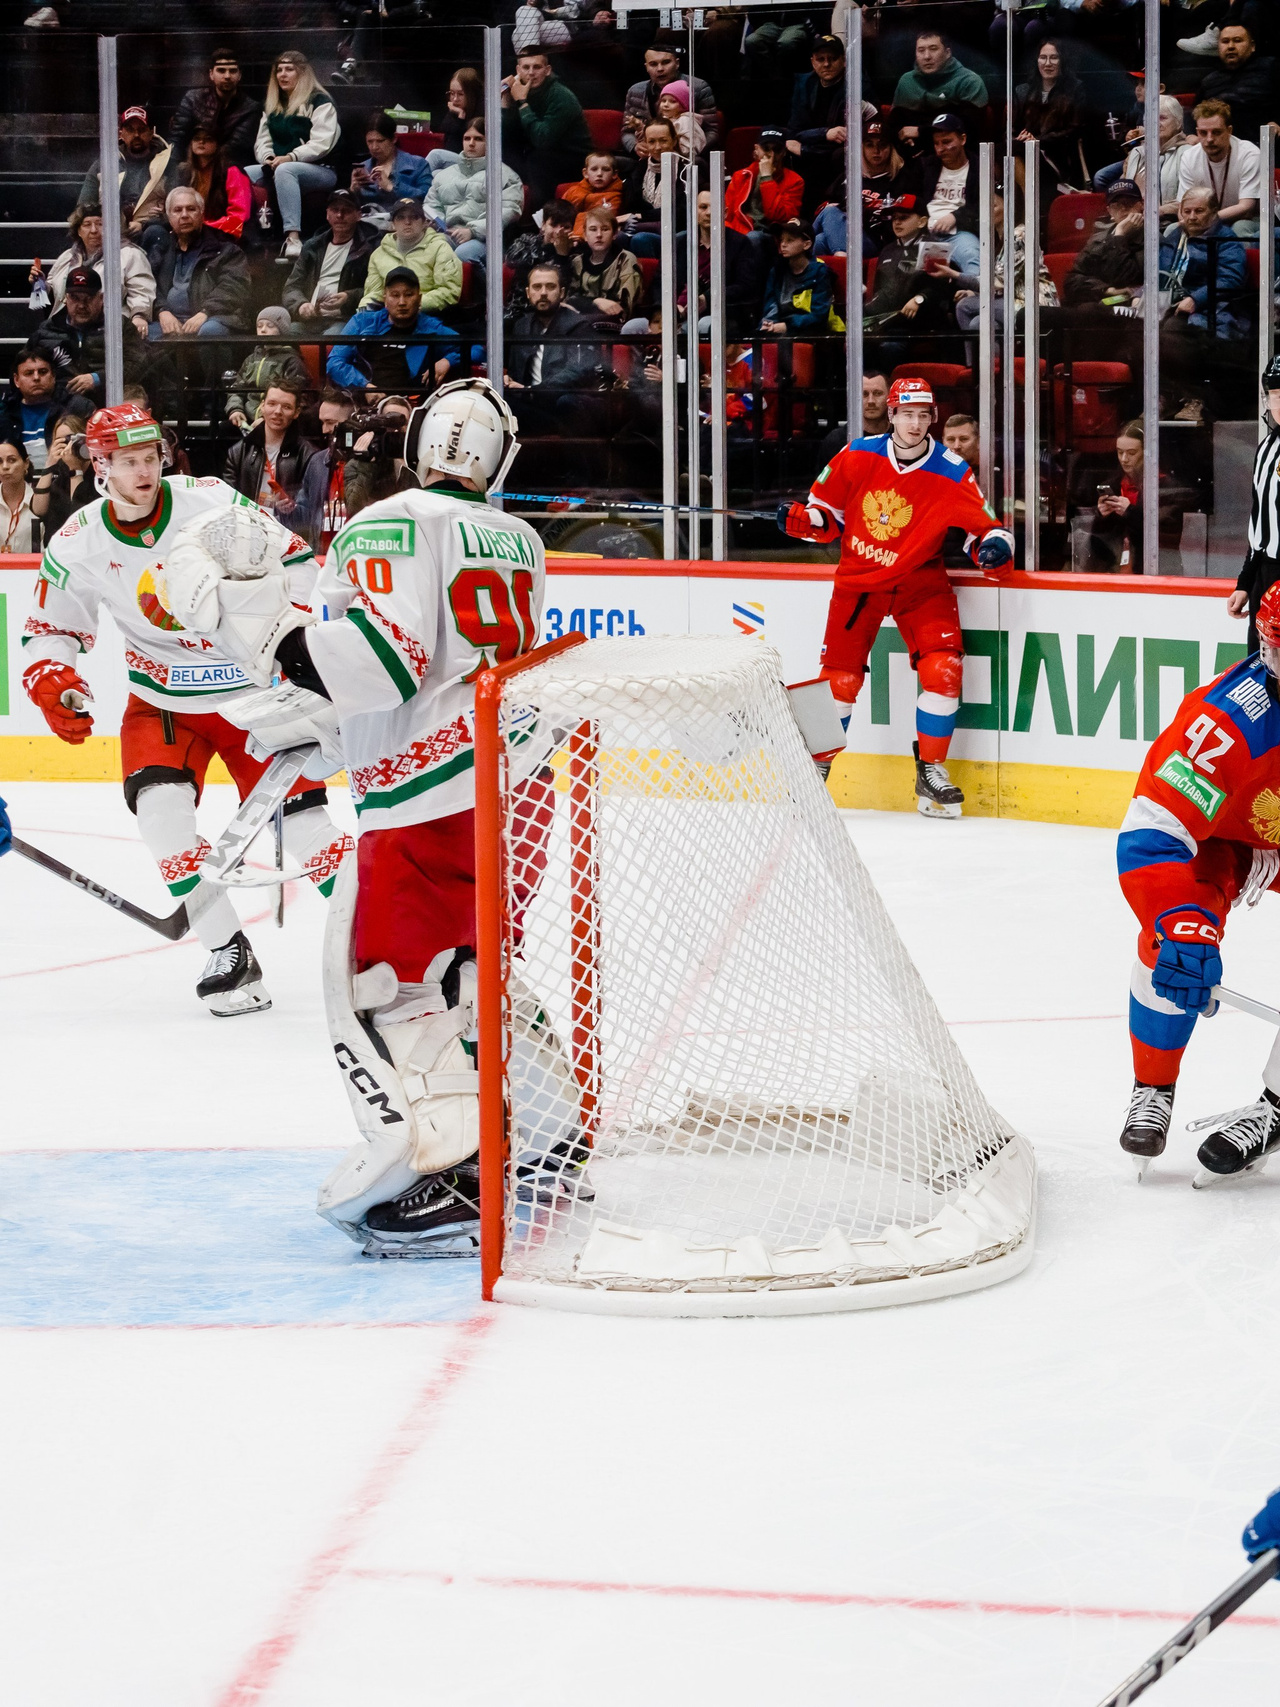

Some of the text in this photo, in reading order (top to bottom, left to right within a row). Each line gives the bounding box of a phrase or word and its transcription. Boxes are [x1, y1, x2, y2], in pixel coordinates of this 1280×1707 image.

[170, 665, 245, 683] BELARUS
[1184, 713, 1236, 775] 92
[69, 870, 125, 909] CCM
[1172, 921, 1221, 943] CC
[334, 1042, 405, 1125] CCM
